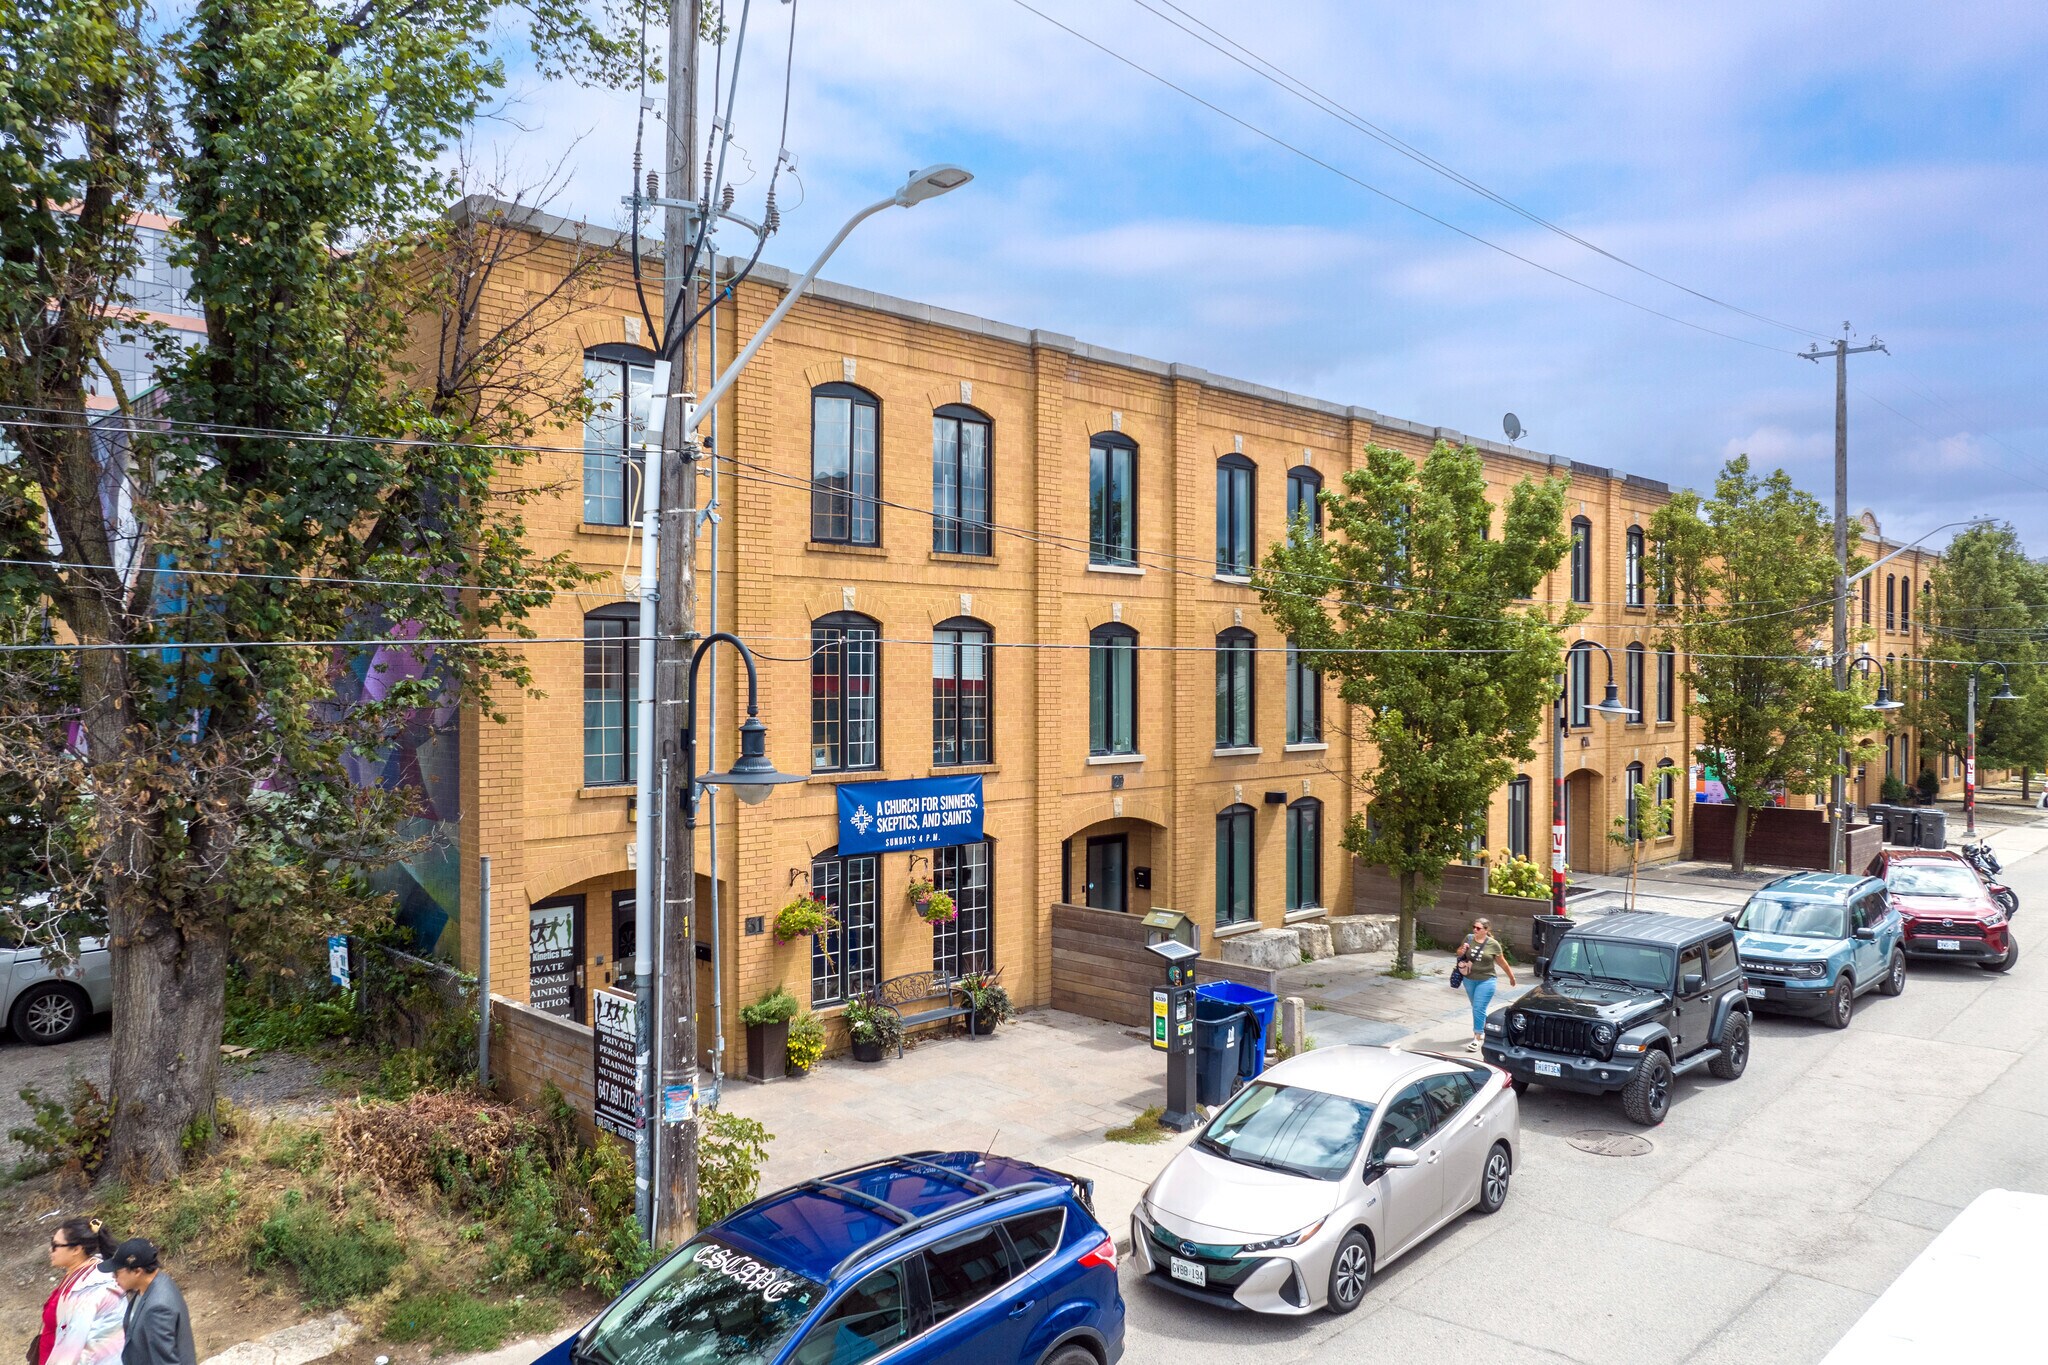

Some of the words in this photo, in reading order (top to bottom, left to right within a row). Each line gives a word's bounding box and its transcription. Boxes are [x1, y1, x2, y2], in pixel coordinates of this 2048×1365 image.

[876, 800, 883, 816] A
[884, 797, 919, 815] CHURCH
[921, 796, 938, 812] FOR
[940, 793, 978, 811] SINNERS,
[876, 814, 920, 833] SKEPTICS,
[921, 812, 940, 828] AND
[942, 809, 972, 826] SAINTS
[885, 835, 916, 847] SUNDAYS
[919, 834, 923, 843] 4
[925, 833, 941, 842] P.M.
[532, 950, 560, 962] Kinetics
[560, 949, 573, 958] Inc.
[530, 962, 565, 974] IVATE
[1741, 963, 1784, 972] RONCO
[530, 973, 570, 986] RSONAL
[530, 985, 568, 999] AINING
[530, 996, 570, 1009] RITION
[602, 1034, 634, 1052] PRIVATE
[600, 1056, 635, 1076] TRAINING
[597, 1078, 636, 1112] 647.691.773
[693, 1243, 795, 1303] ESCAPE
